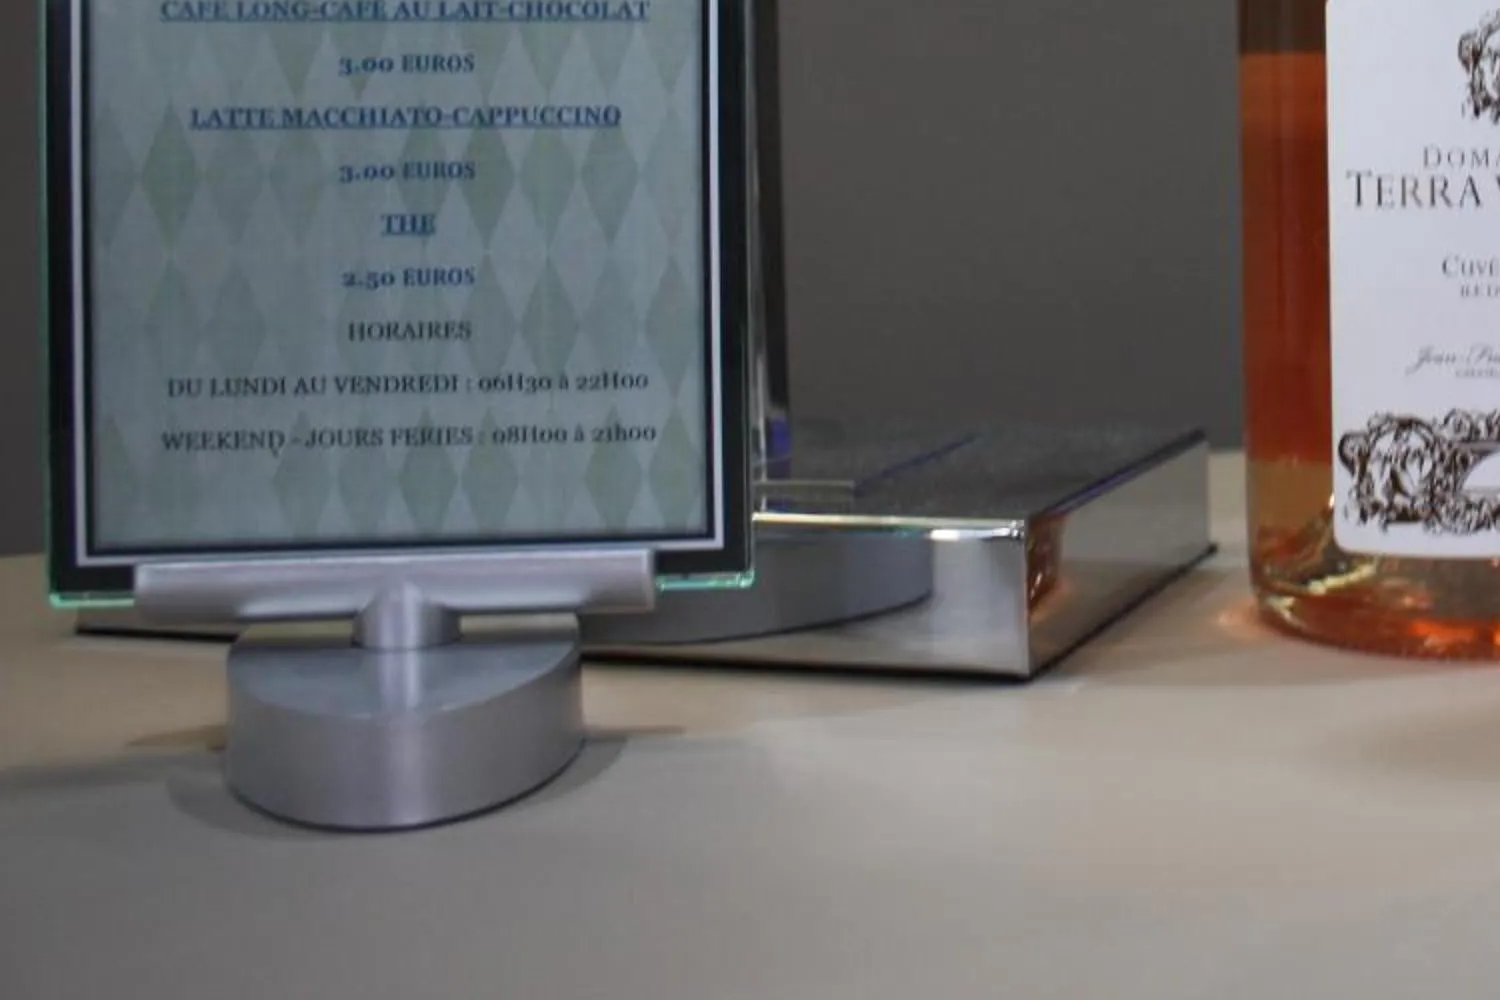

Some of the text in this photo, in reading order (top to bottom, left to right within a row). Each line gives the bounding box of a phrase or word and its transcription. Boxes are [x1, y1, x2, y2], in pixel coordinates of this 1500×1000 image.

[393, 0, 431, 21] AU
[401, 53, 475, 75] EUROS
[189, 106, 275, 130] LATTE
[338, 160, 476, 184] 3.00 EUROS
[1345, 169, 1484, 210] TERRA
[380, 213, 436, 236] THE
[403, 266, 476, 288] EUROS
[347, 320, 473, 343] HORAIRES
[167, 376, 202, 399] DU
[209, 375, 287, 399] LUNDI
[293, 374, 327, 396] AU
[332, 373, 459, 395] VENDREDI
[304, 427, 384, 450] JOURS
[390, 425, 474, 447] FERIES
